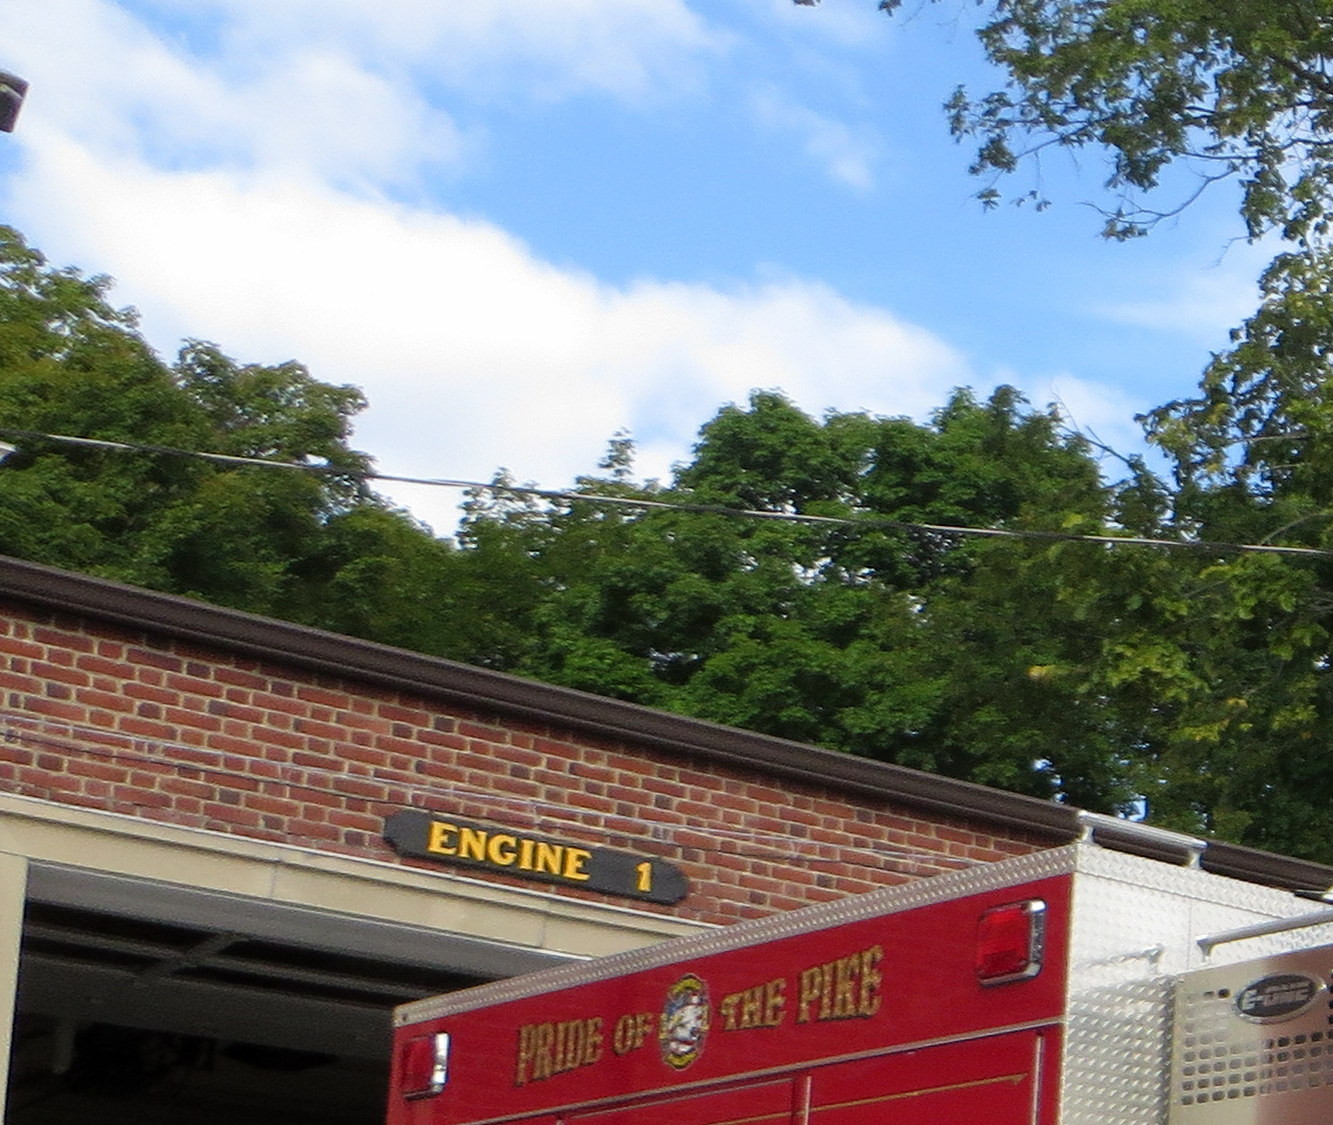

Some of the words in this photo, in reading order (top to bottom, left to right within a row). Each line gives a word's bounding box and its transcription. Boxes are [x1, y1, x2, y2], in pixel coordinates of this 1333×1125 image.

[427, 820, 593, 881] ENGINE
[635, 861, 653, 892] 1
[514, 1016, 603, 1088] PRIDE
[611, 1013, 652, 1056] OF
[718, 977, 787, 1031] THE
[796, 944, 884, 1025] PIKE
